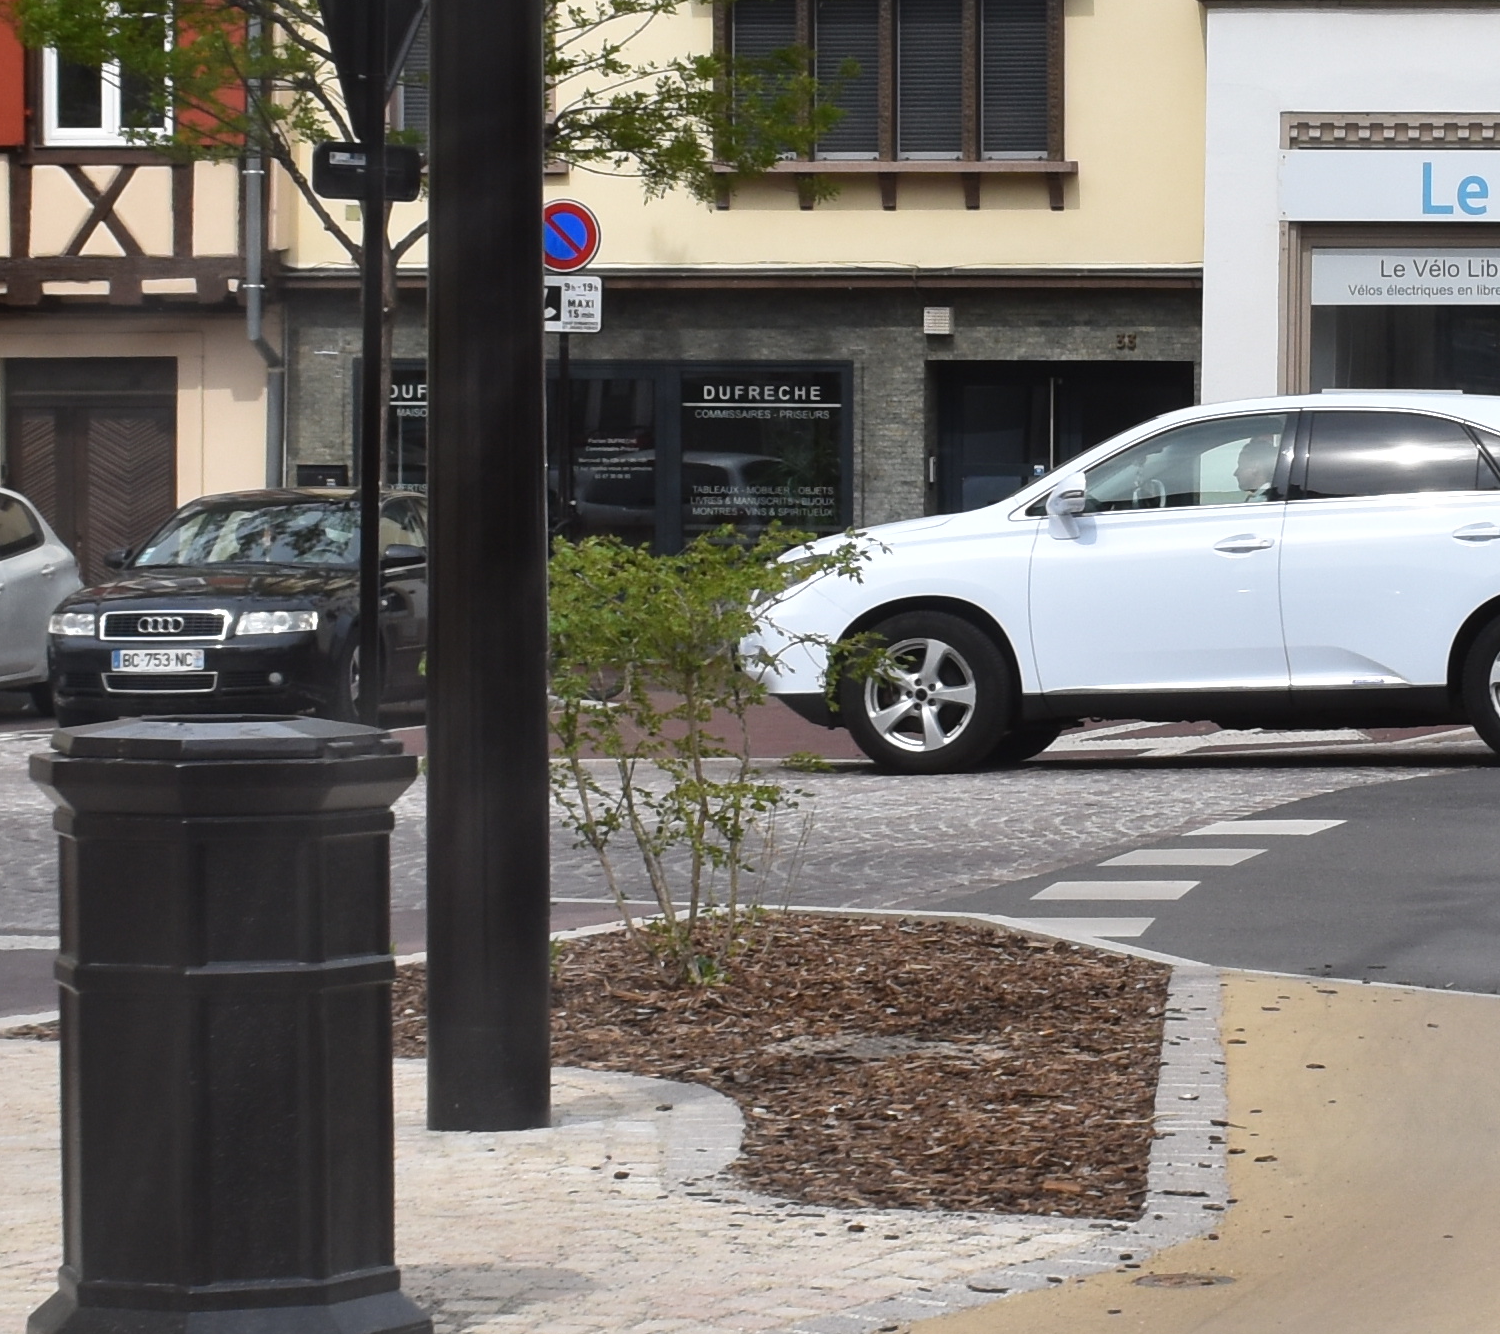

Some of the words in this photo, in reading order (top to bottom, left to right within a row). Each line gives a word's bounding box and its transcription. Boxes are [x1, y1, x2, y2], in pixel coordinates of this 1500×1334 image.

[1422, 161, 1489, 217] Le
[1380, 259, 1406, 278] Le
[1413, 259, 1460, 278] Vélo
[1348, 284, 1383, 296] Vélos
[1386, 284, 1454, 298] électriques
[1457, 286, 1473, 296] en
[567, 299, 595, 309] MAXI
[703, 385, 822, 401] DUFRECHE
[694, 409, 771, 419] COMMISSAIRES
[779, 410, 830, 420] PRISEURS
[692, 485, 739, 494] TABLEAUX
[692, 507, 738, 516] MONTRES
[122, 652, 193, 668] BC-753-NC
